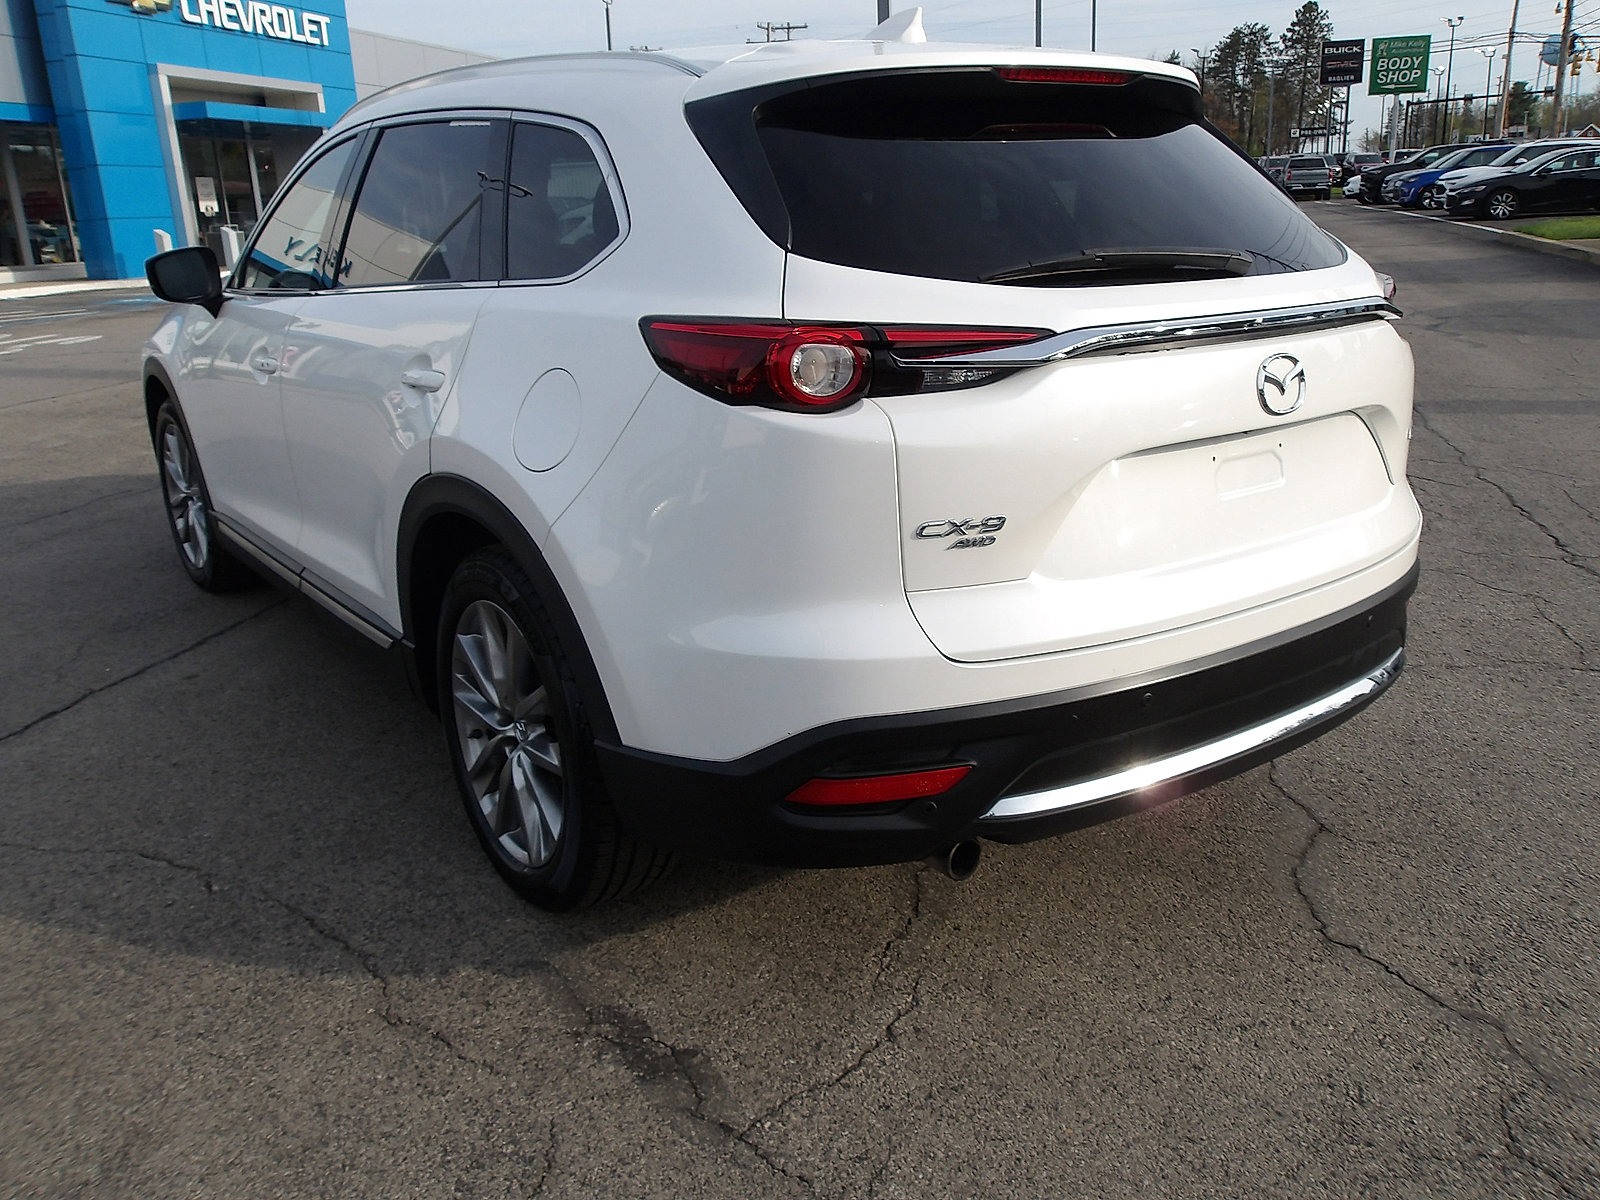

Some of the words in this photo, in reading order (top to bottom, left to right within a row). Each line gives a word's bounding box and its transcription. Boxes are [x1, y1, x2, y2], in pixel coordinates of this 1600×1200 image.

[180, 0, 331, 46] CHEVROLET
[1324, 46, 1362, 54] BUICK
[1377, 56, 1424, 71] BODY
[1377, 69, 1421, 83] SHOP
[916, 514, 1007, 539] CX-9
[944, 535, 997, 551] AWD
